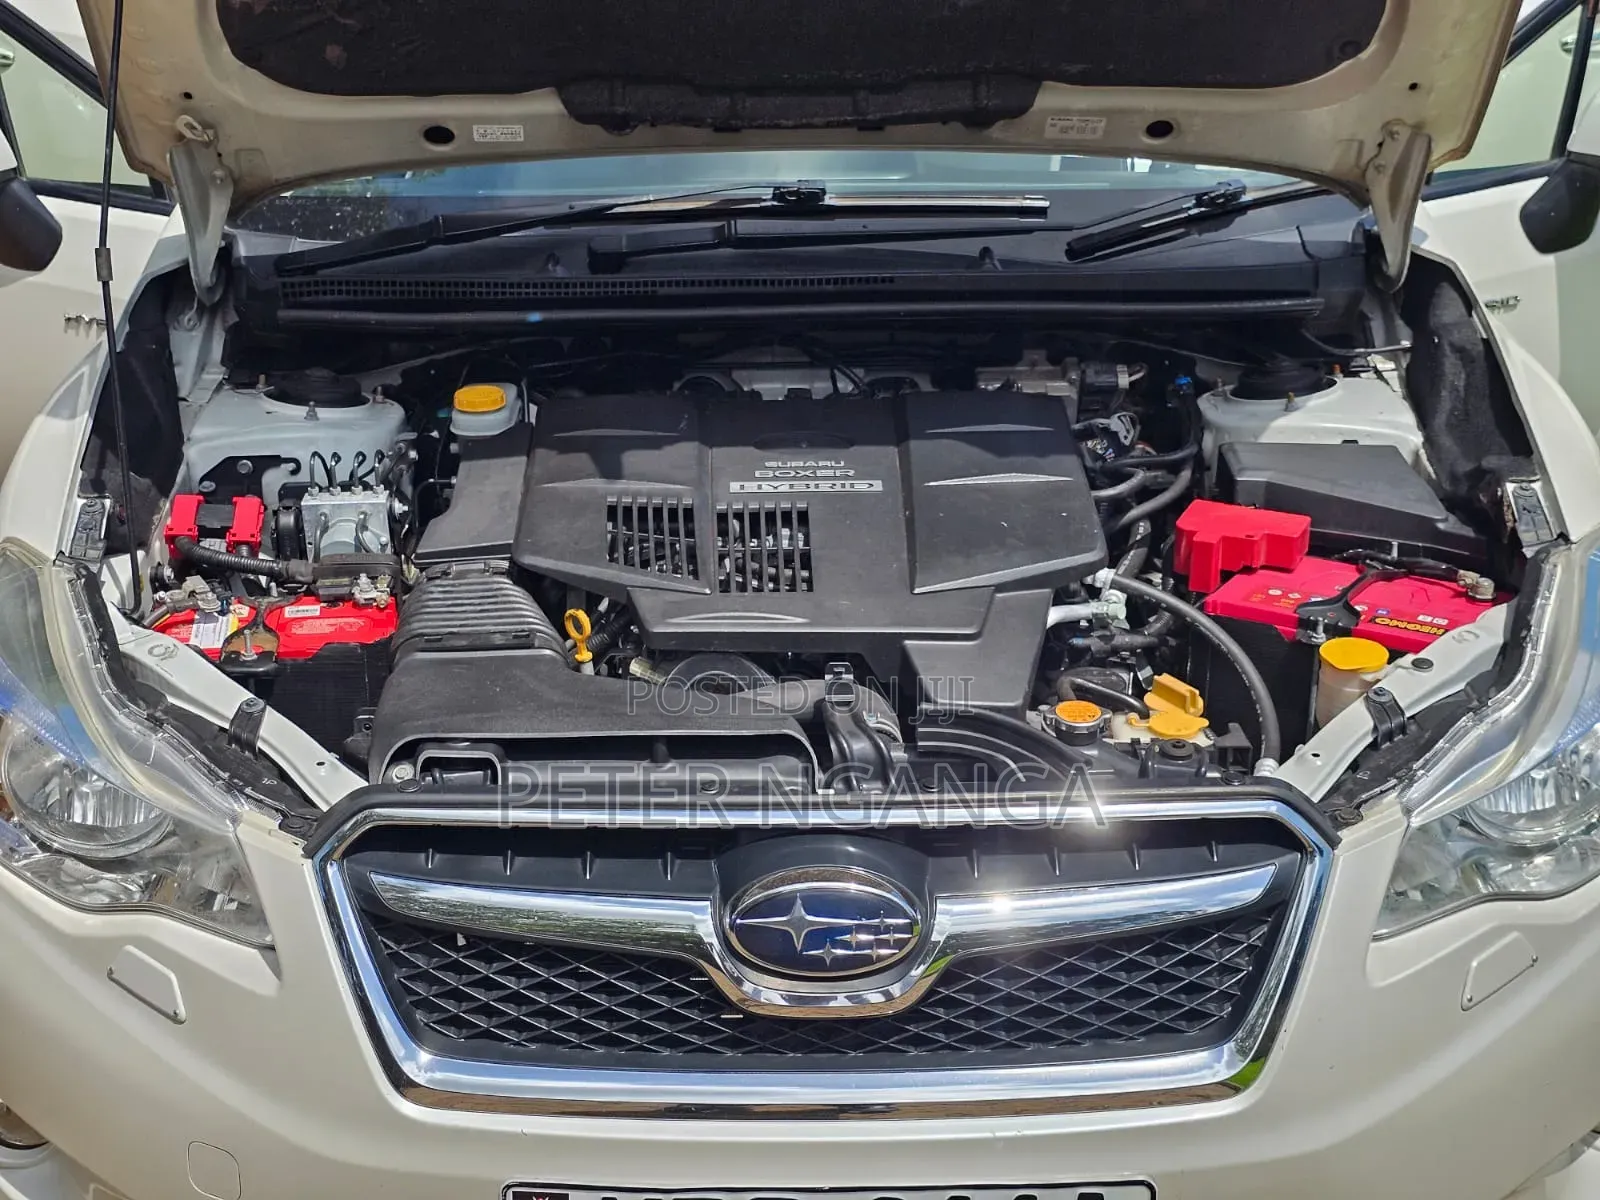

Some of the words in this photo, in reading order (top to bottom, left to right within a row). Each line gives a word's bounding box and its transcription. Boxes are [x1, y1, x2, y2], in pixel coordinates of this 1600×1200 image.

[764, 460, 845, 468] SUBARU
[754, 469, 856, 478] BOXER
[737, 481, 877, 492] HYBRID
